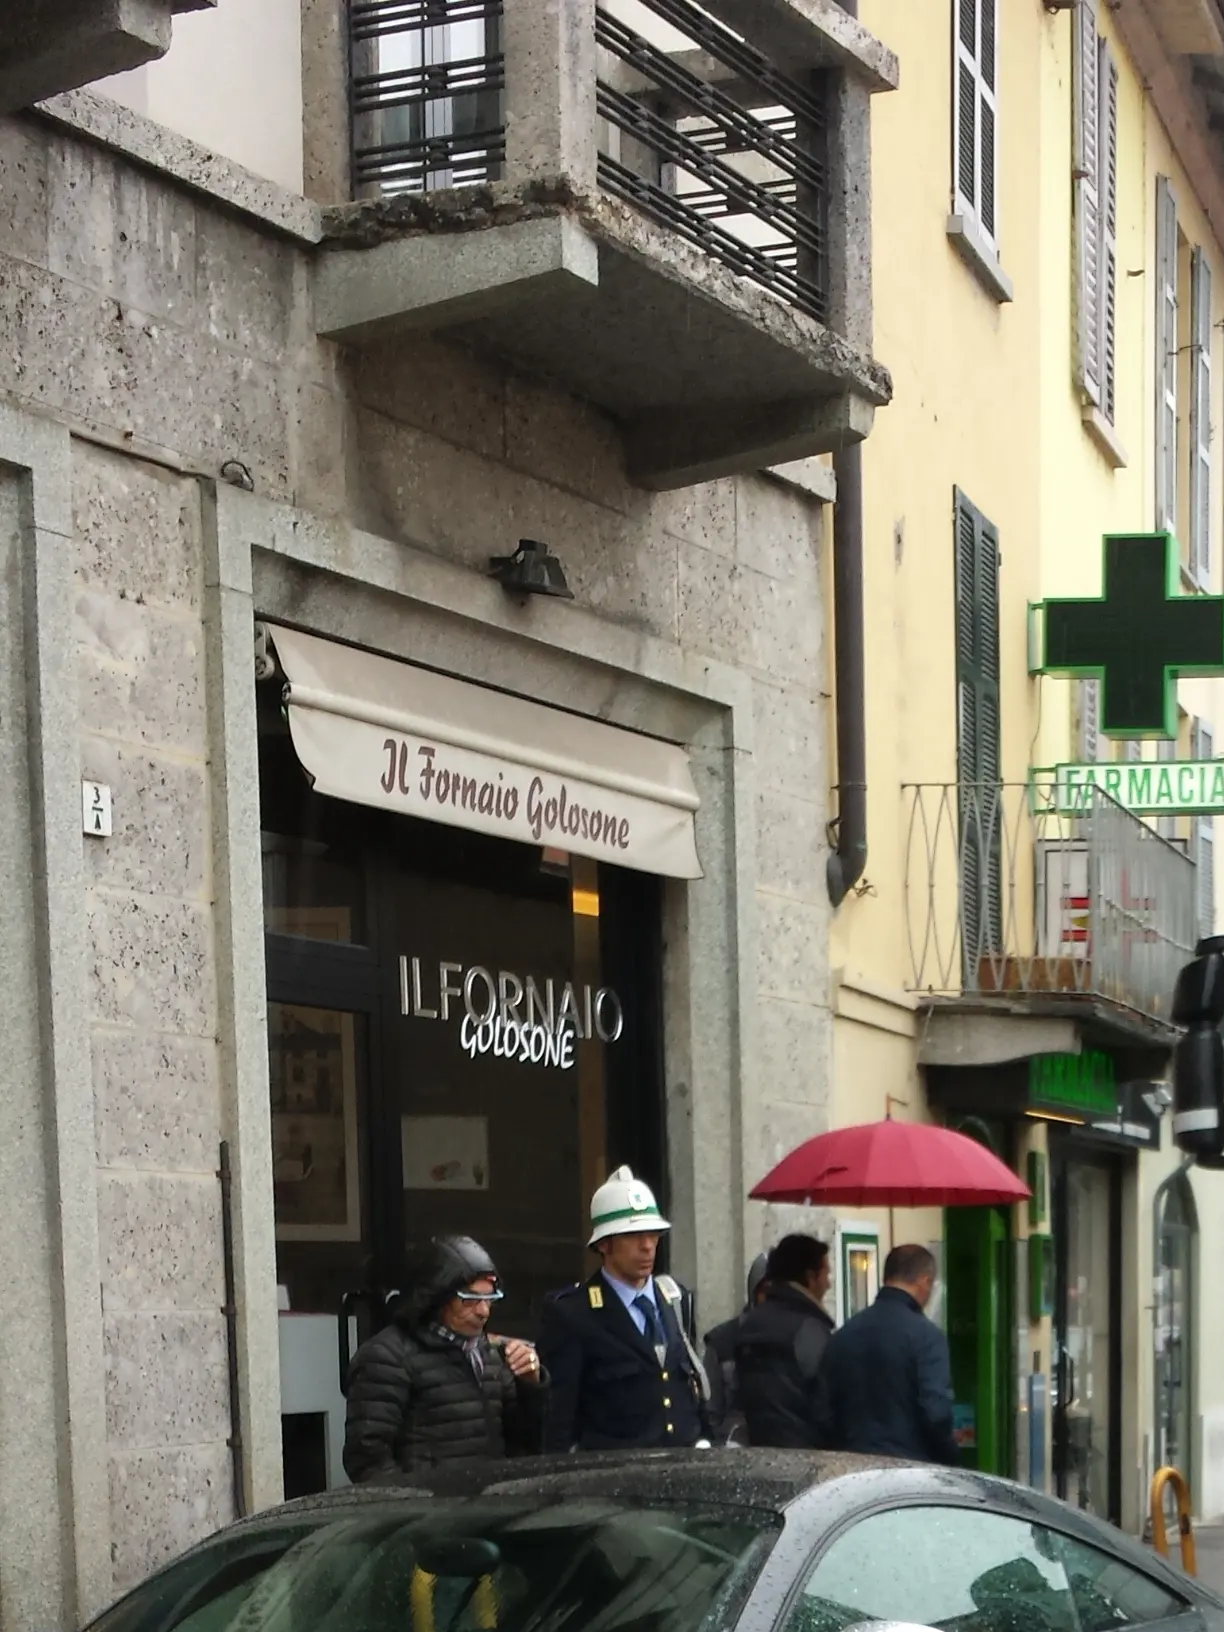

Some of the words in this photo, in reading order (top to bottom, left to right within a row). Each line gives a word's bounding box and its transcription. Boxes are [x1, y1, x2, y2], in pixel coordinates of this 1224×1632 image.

[93, 786, 101, 804] 3
[380, 739, 410, 795] Il
[418, 745, 519, 821] Fornaio
[526, 776, 630, 850] Golosone
[460, 1012, 575, 1070] GOLOSONE
